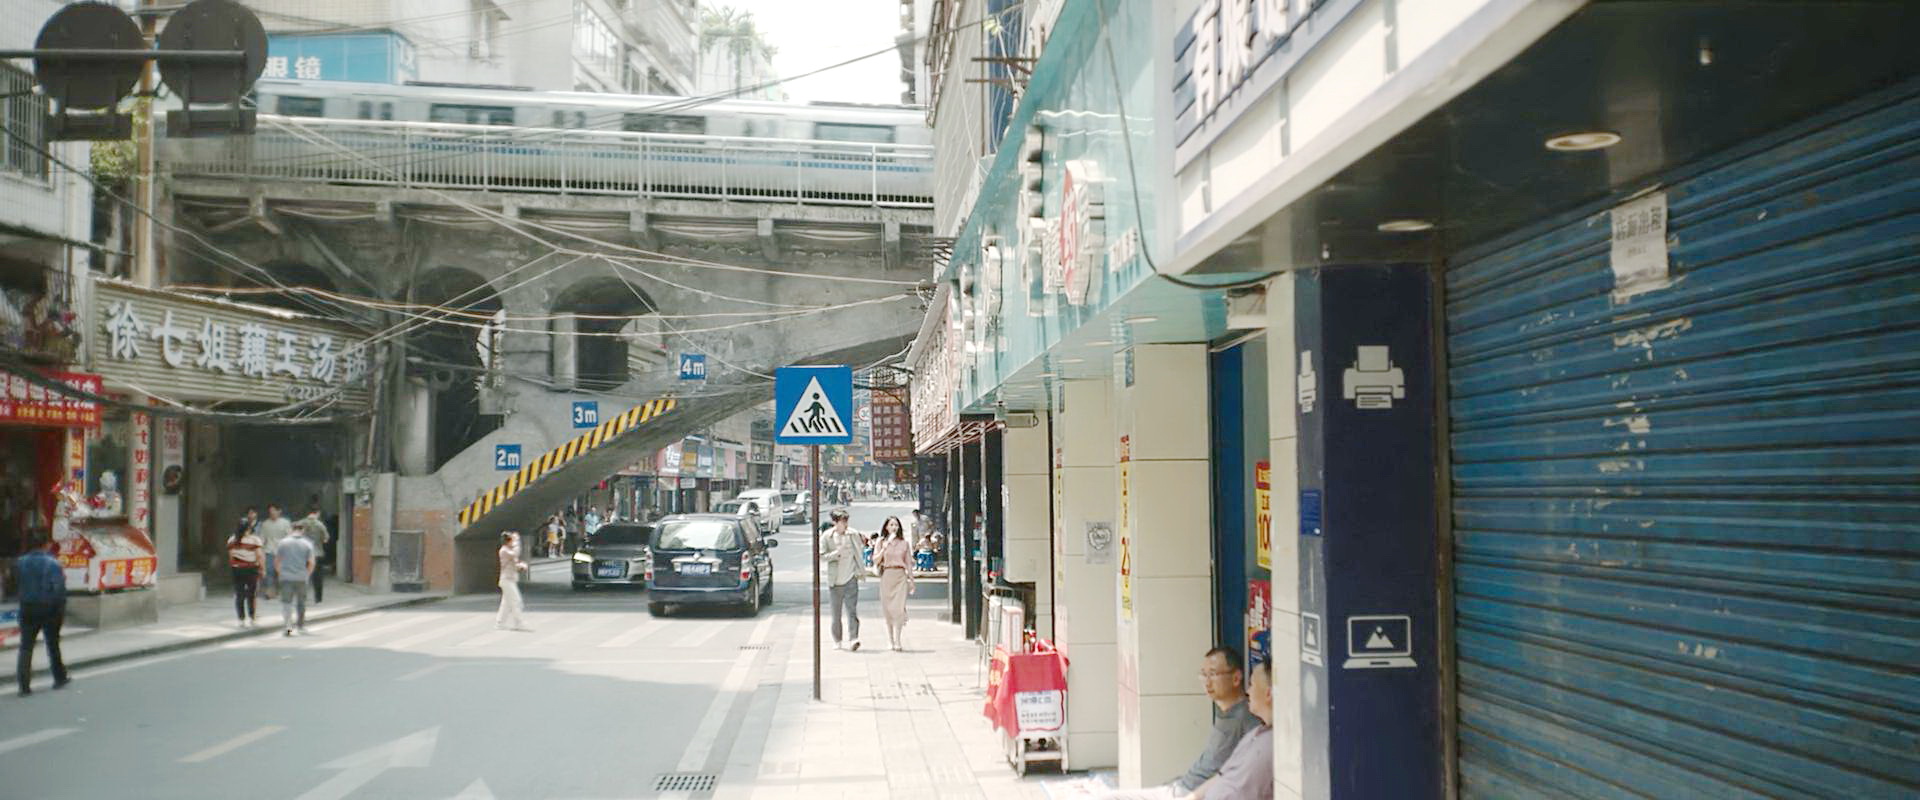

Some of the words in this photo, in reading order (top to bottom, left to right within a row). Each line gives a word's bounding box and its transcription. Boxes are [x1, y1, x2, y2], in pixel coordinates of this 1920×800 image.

[682, 358, 704, 375] 4m
[574, 406, 597, 423] 3m
[496, 449, 520, 467] 2m
